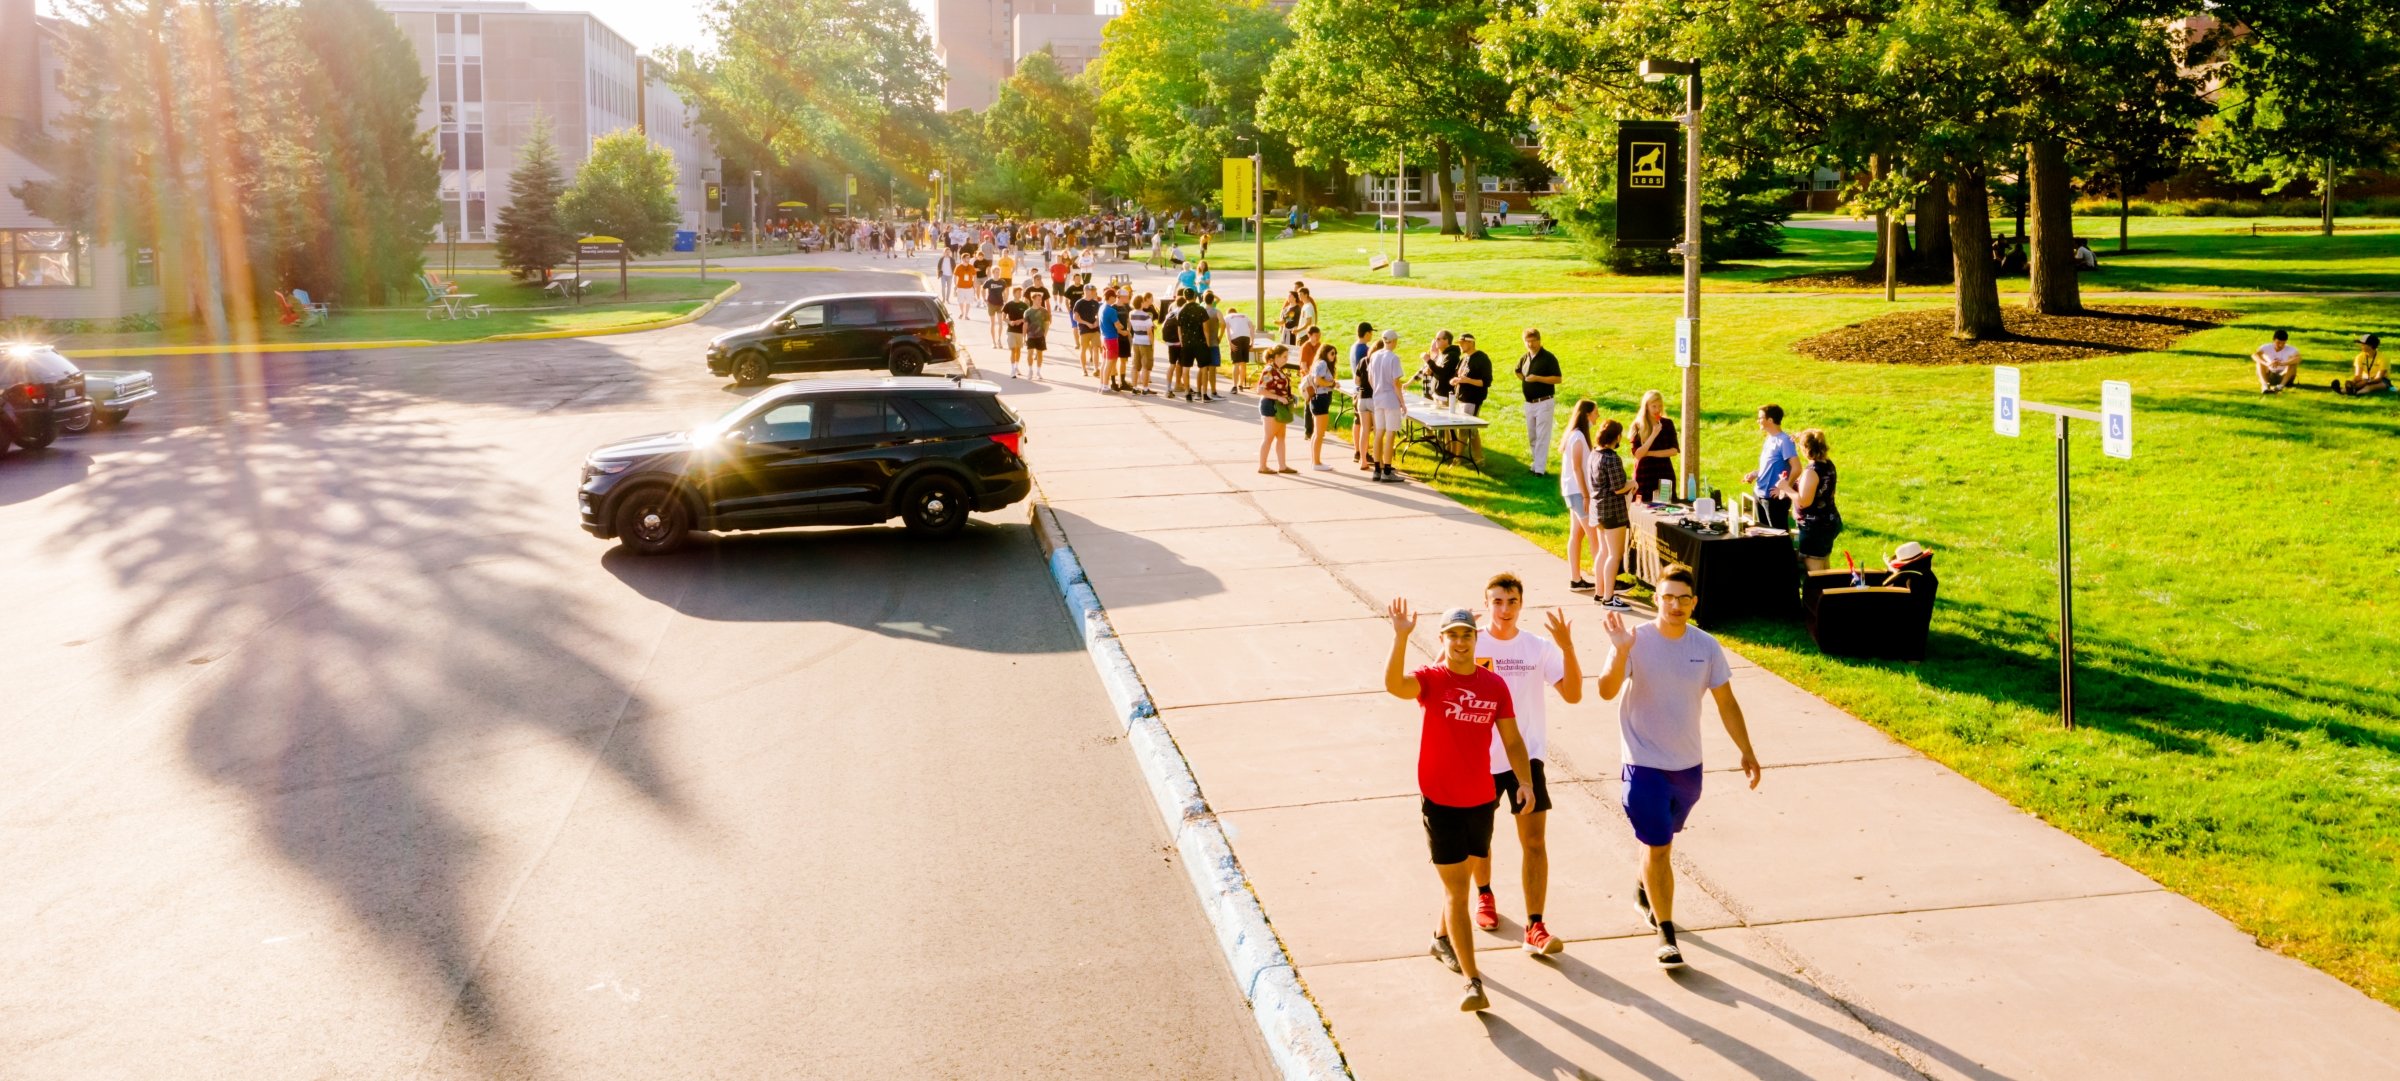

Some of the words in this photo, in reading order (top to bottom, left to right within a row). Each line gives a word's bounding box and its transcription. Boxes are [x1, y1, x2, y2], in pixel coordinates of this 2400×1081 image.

[634, 177, 661, 185] 1885
[1496, 658, 1524, 666] Michigan
[1455, 687, 1498, 710] Pizza
[1442, 700, 1492, 723] Planet
